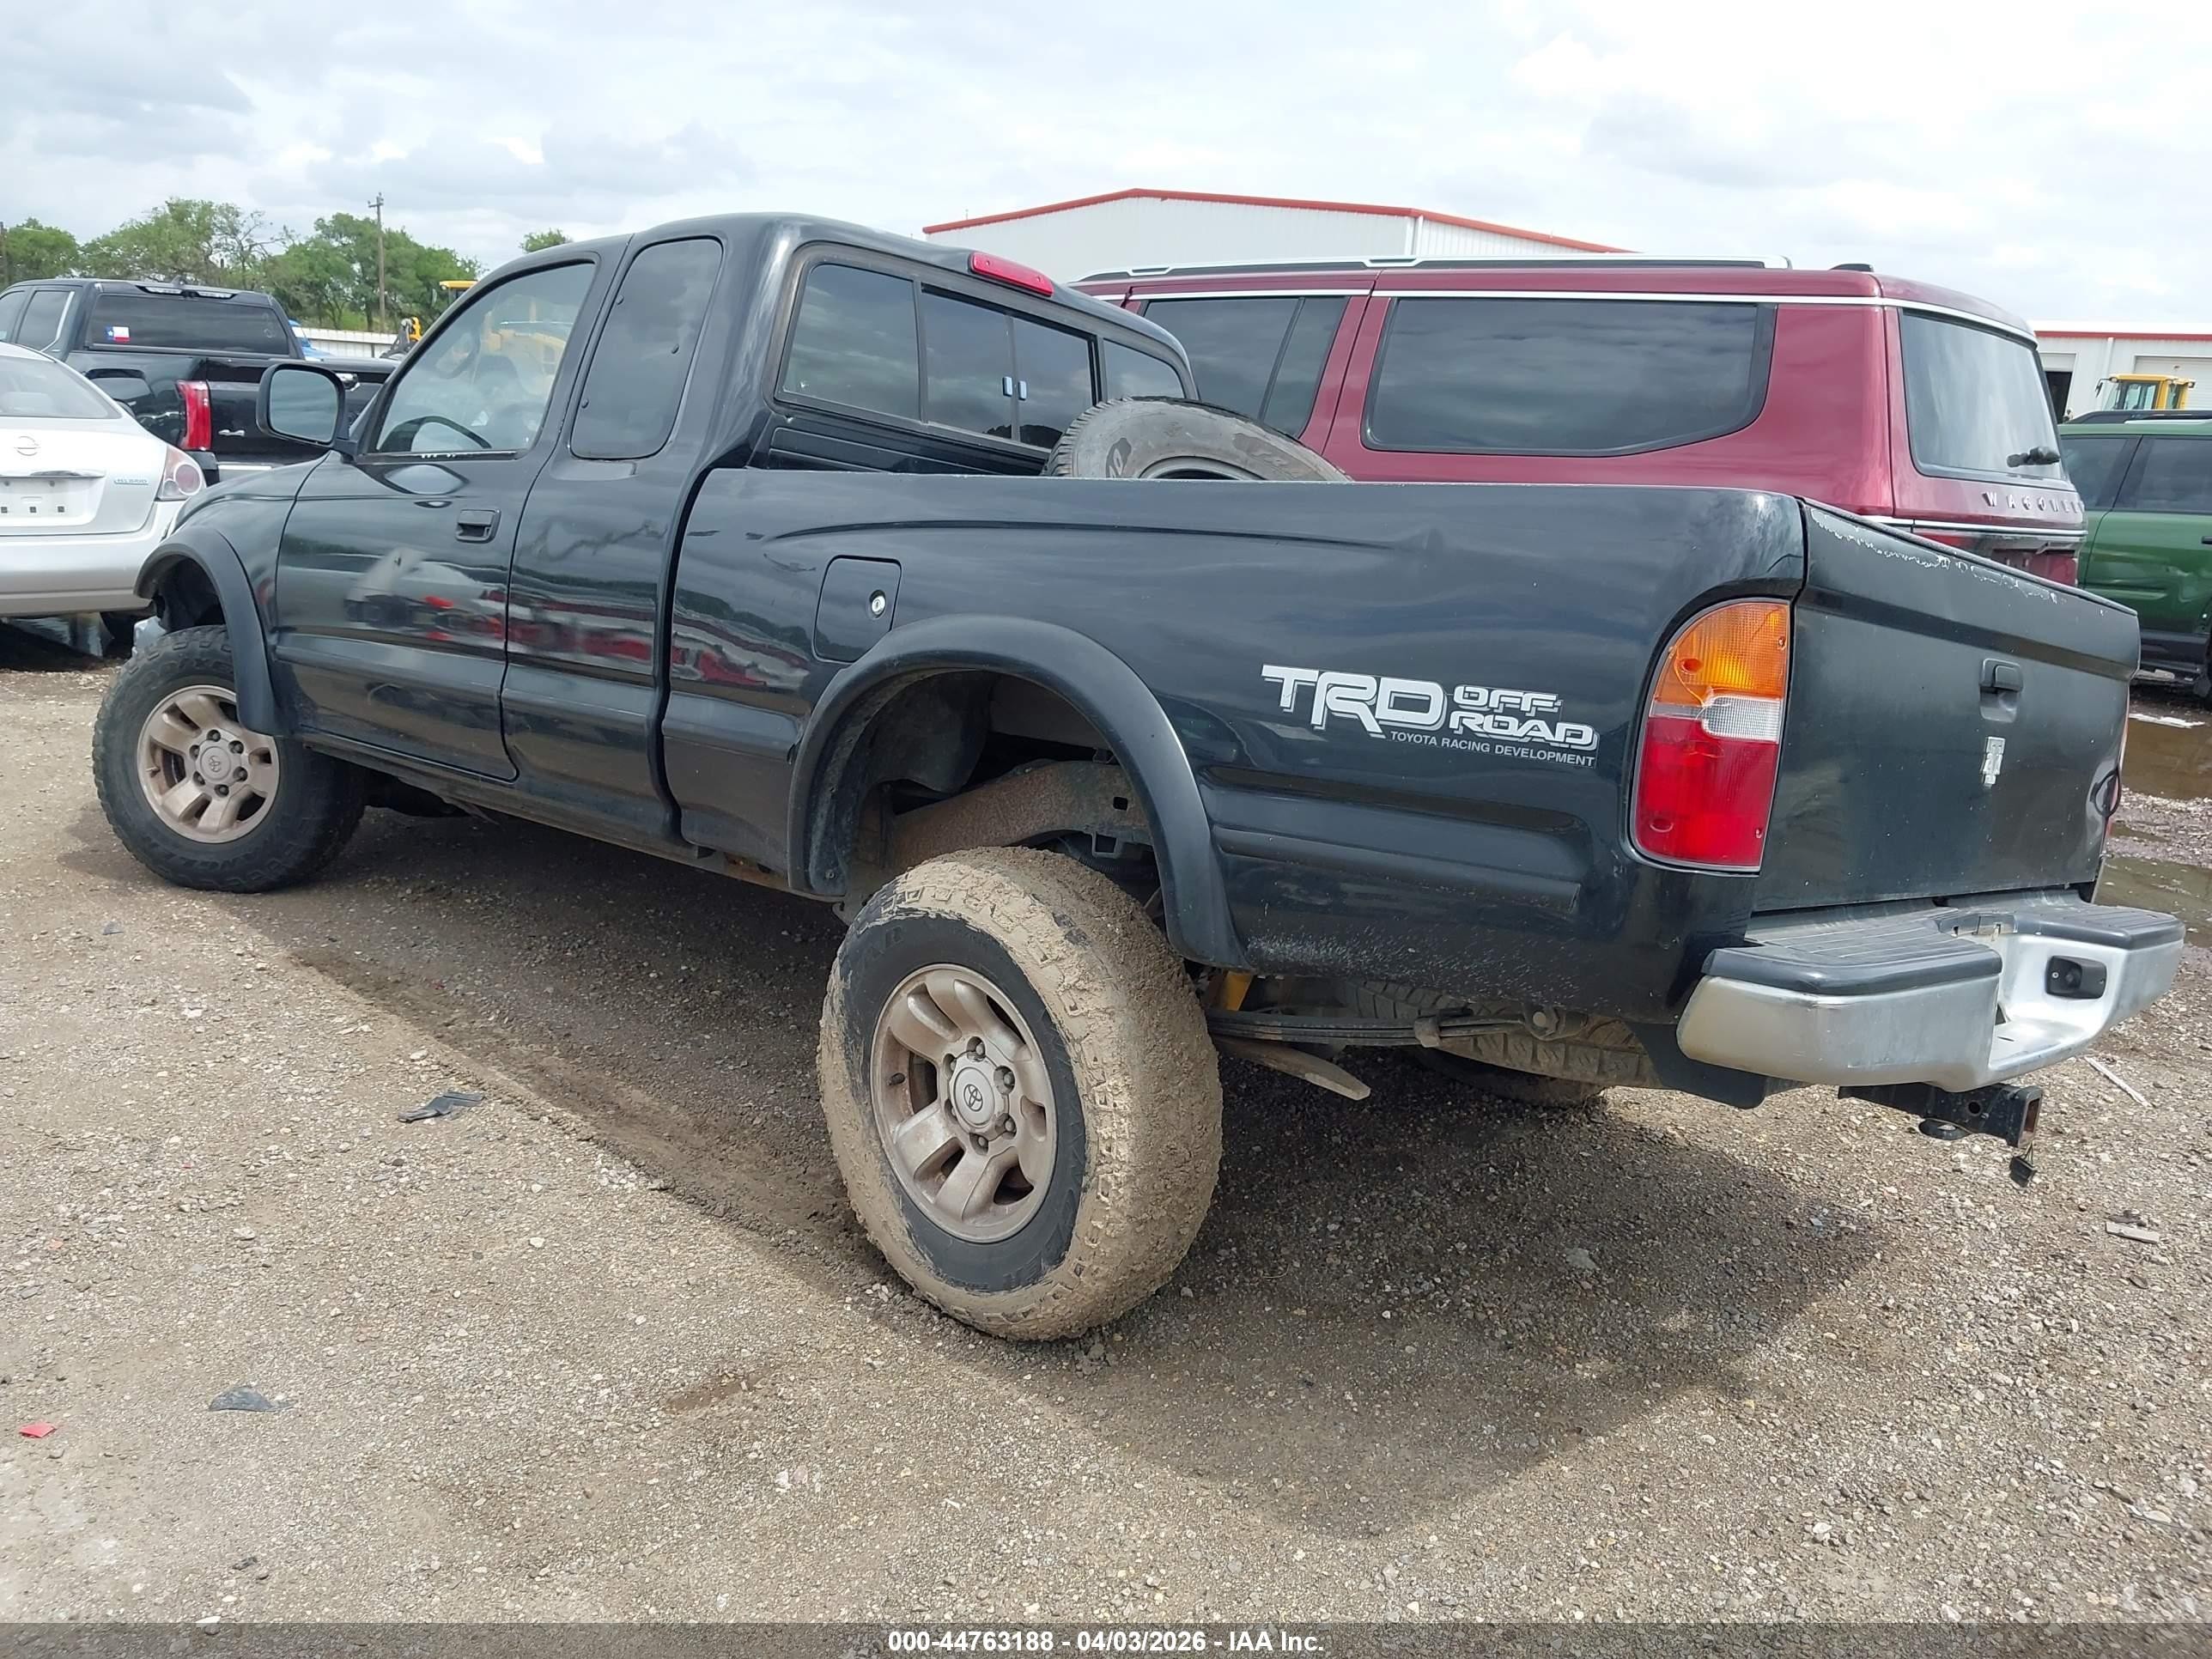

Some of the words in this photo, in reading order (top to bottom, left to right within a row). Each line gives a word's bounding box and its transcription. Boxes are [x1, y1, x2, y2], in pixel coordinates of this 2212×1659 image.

[1261, 664, 1448, 739] TRD
[1453, 684, 1563, 716] OFF
[1389, 730, 1437, 747] TOYOTA
[1441, 738, 1491, 753] RACING
[1494, 744, 1595, 768] DEVELOPMENT
[1449, 711, 1600, 751] ROAD
